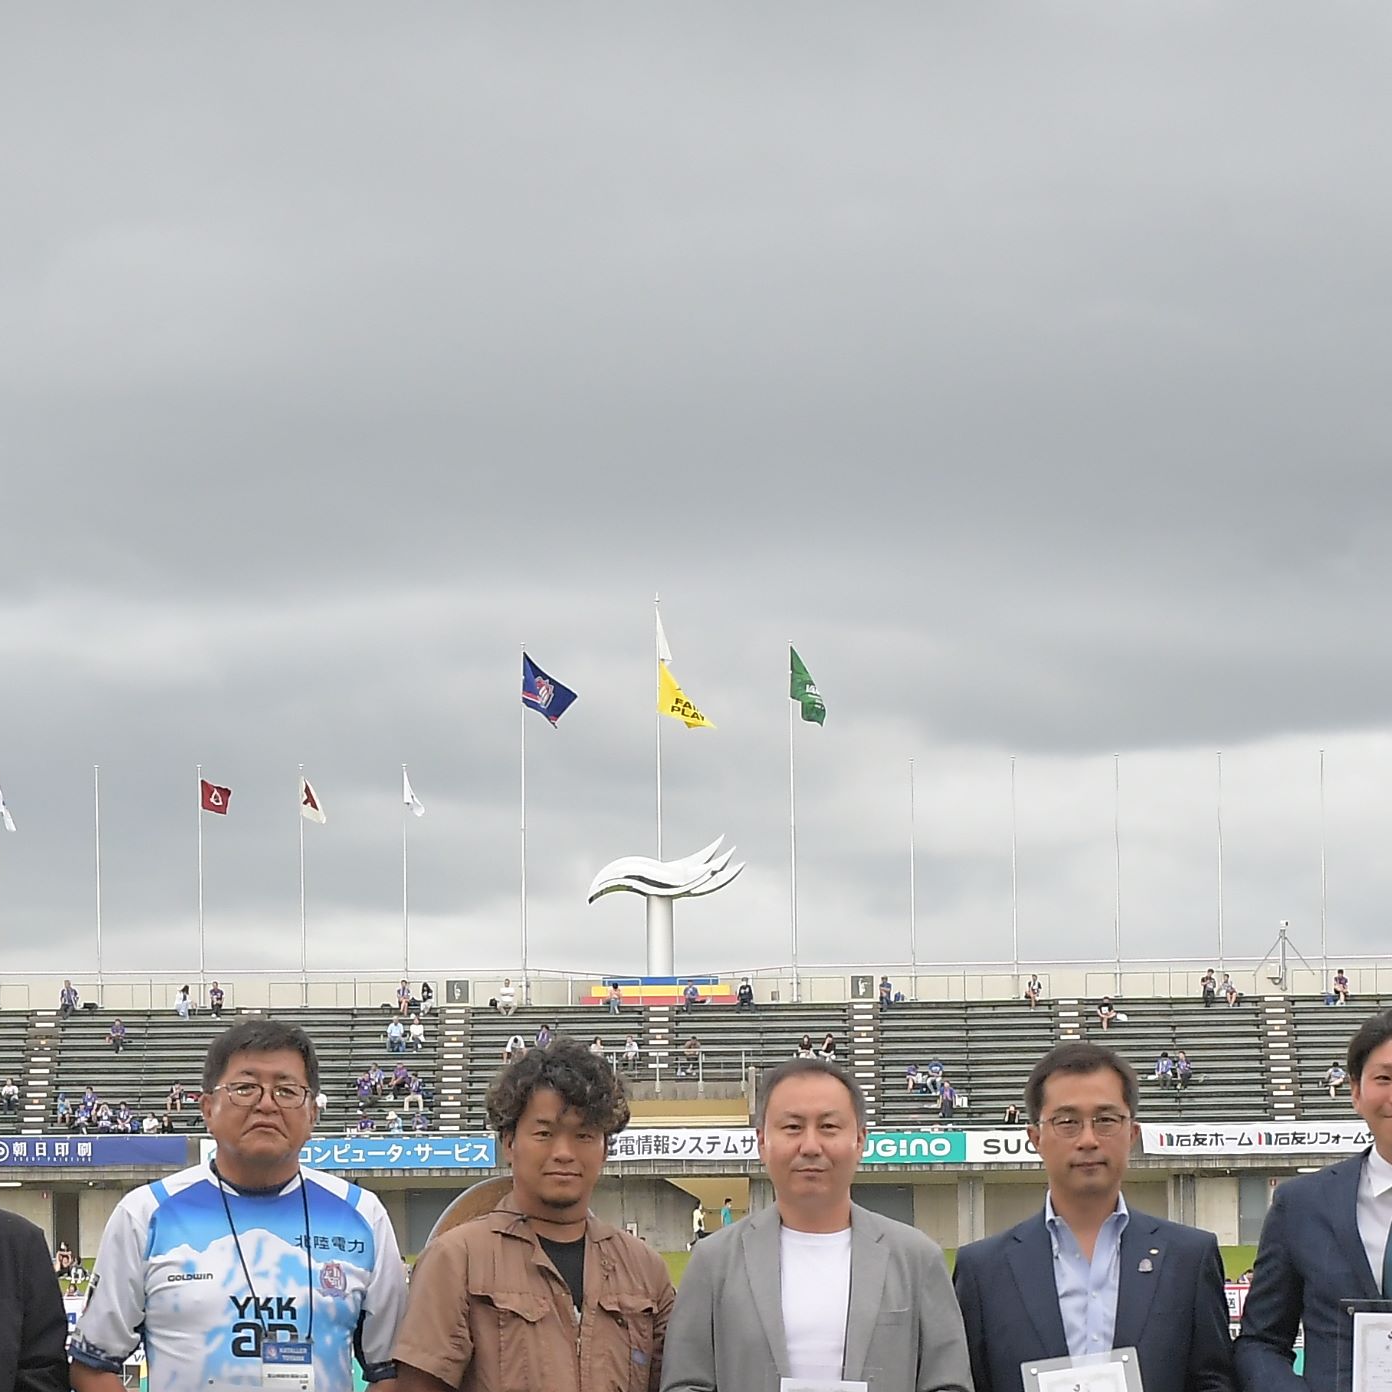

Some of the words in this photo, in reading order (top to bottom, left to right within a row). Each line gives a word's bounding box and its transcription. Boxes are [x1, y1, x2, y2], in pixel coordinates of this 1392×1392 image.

[1175, 1131, 1253, 1147] 石友ホーム
[12, 1141, 92, 1157] 朝日印刷
[295, 1235, 364, 1253] 北陸電力
[229, 1297, 297, 1320] YKK
